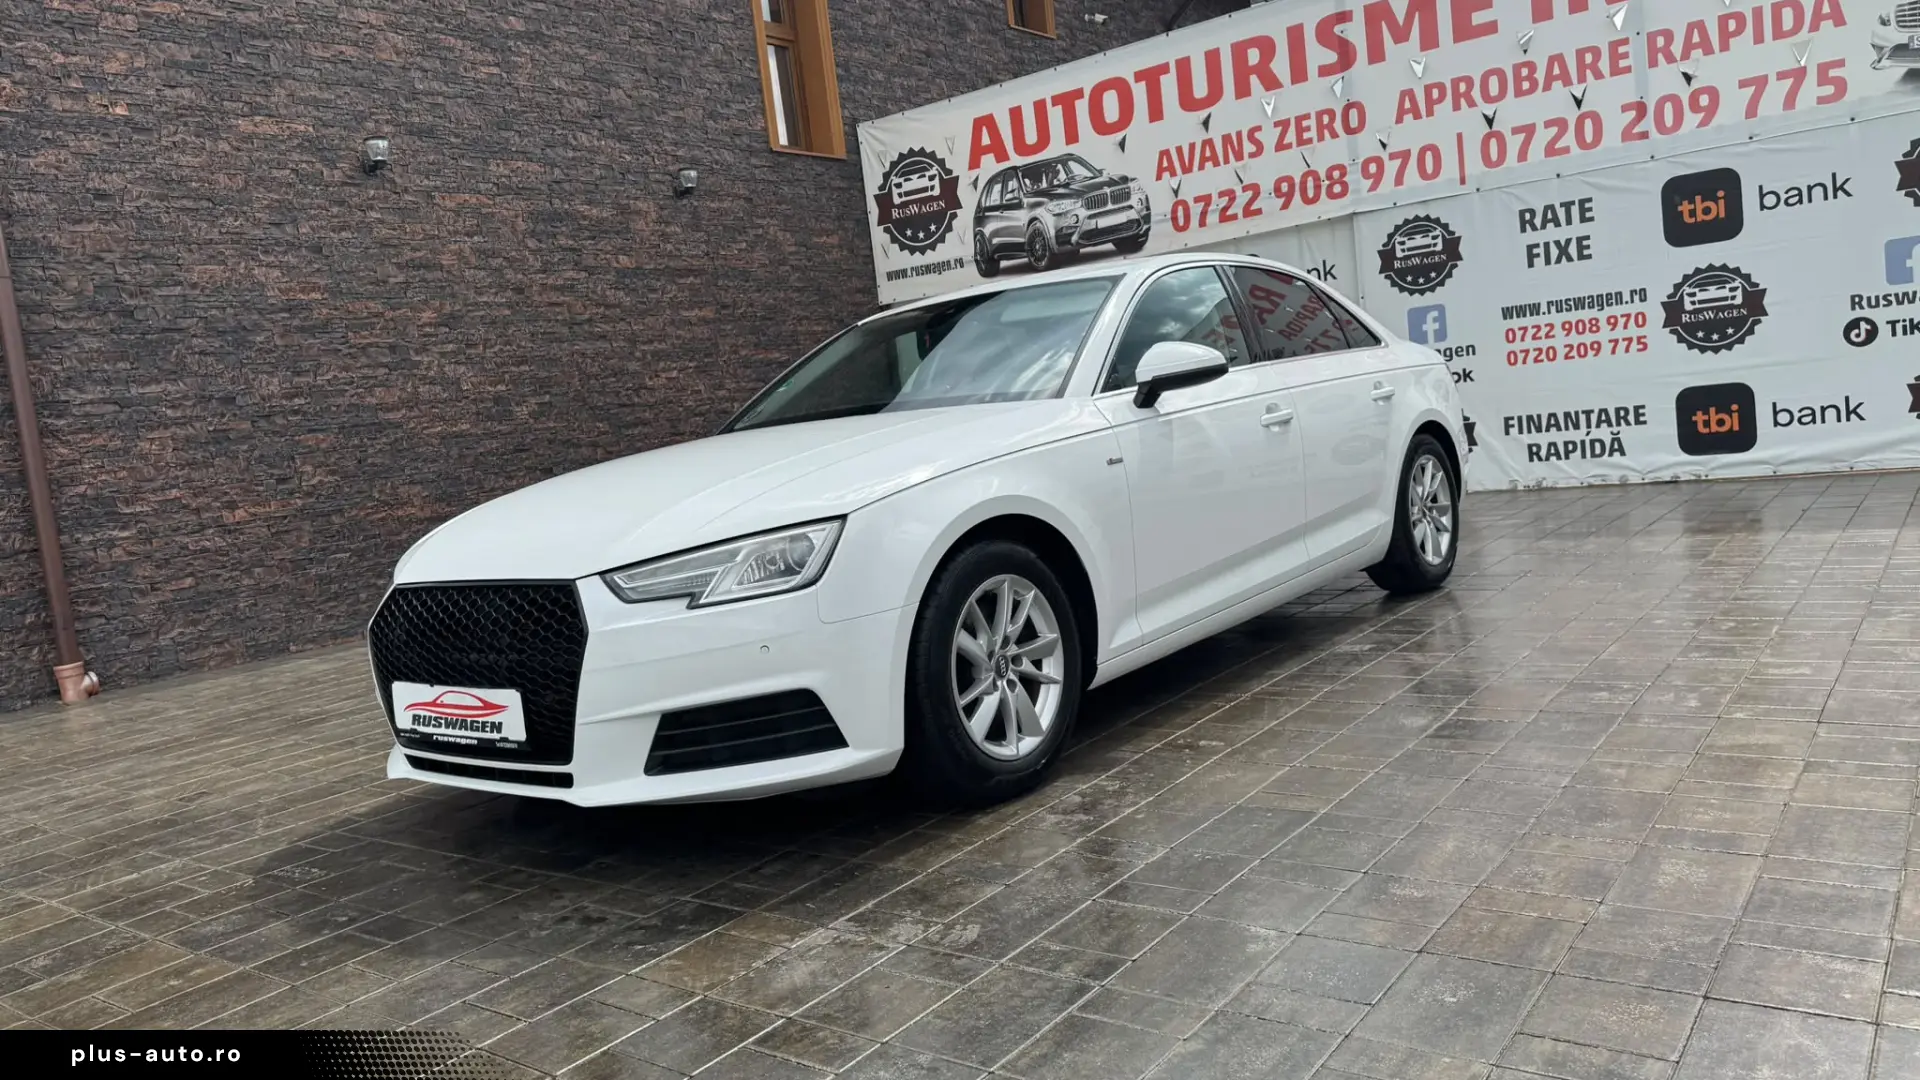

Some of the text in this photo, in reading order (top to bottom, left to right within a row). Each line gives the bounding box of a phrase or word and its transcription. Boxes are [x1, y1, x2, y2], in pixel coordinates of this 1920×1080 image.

[968, 0, 1499, 171] AUTOTURISME
[1155, 0, 1848, 182] AVANS ZERO APROBARE RAPIDA
[1170, 183, 1263, 233] 0722
[1273, 163, 1349, 211] 908
[1360, 143, 1443, 193] 970
[1480, 110, 1604, 169] 0720
[1620, 85, 1720, 143] 209
[1738, 58, 1849, 120] 775
[1677, 172, 1853, 223] tbi bank
[1518, 197, 1595, 234] RATE
[1526, 235, 1593, 269] FIXE
[886, 257, 965, 282] www.ruswagen.ro
[1501, 287, 1648, 320] www.ruswagen.ro
[1504, 311, 1647, 344] 0722 908 970
[1506, 335, 1649, 367] 0720 209 775
[1692, 395, 1867, 434] tbi bank
[1527, 430, 1627, 463] RAPIDĂ
[411, 714, 503, 734] RUSWAGEN
[433, 734, 478, 745] ruswagen
